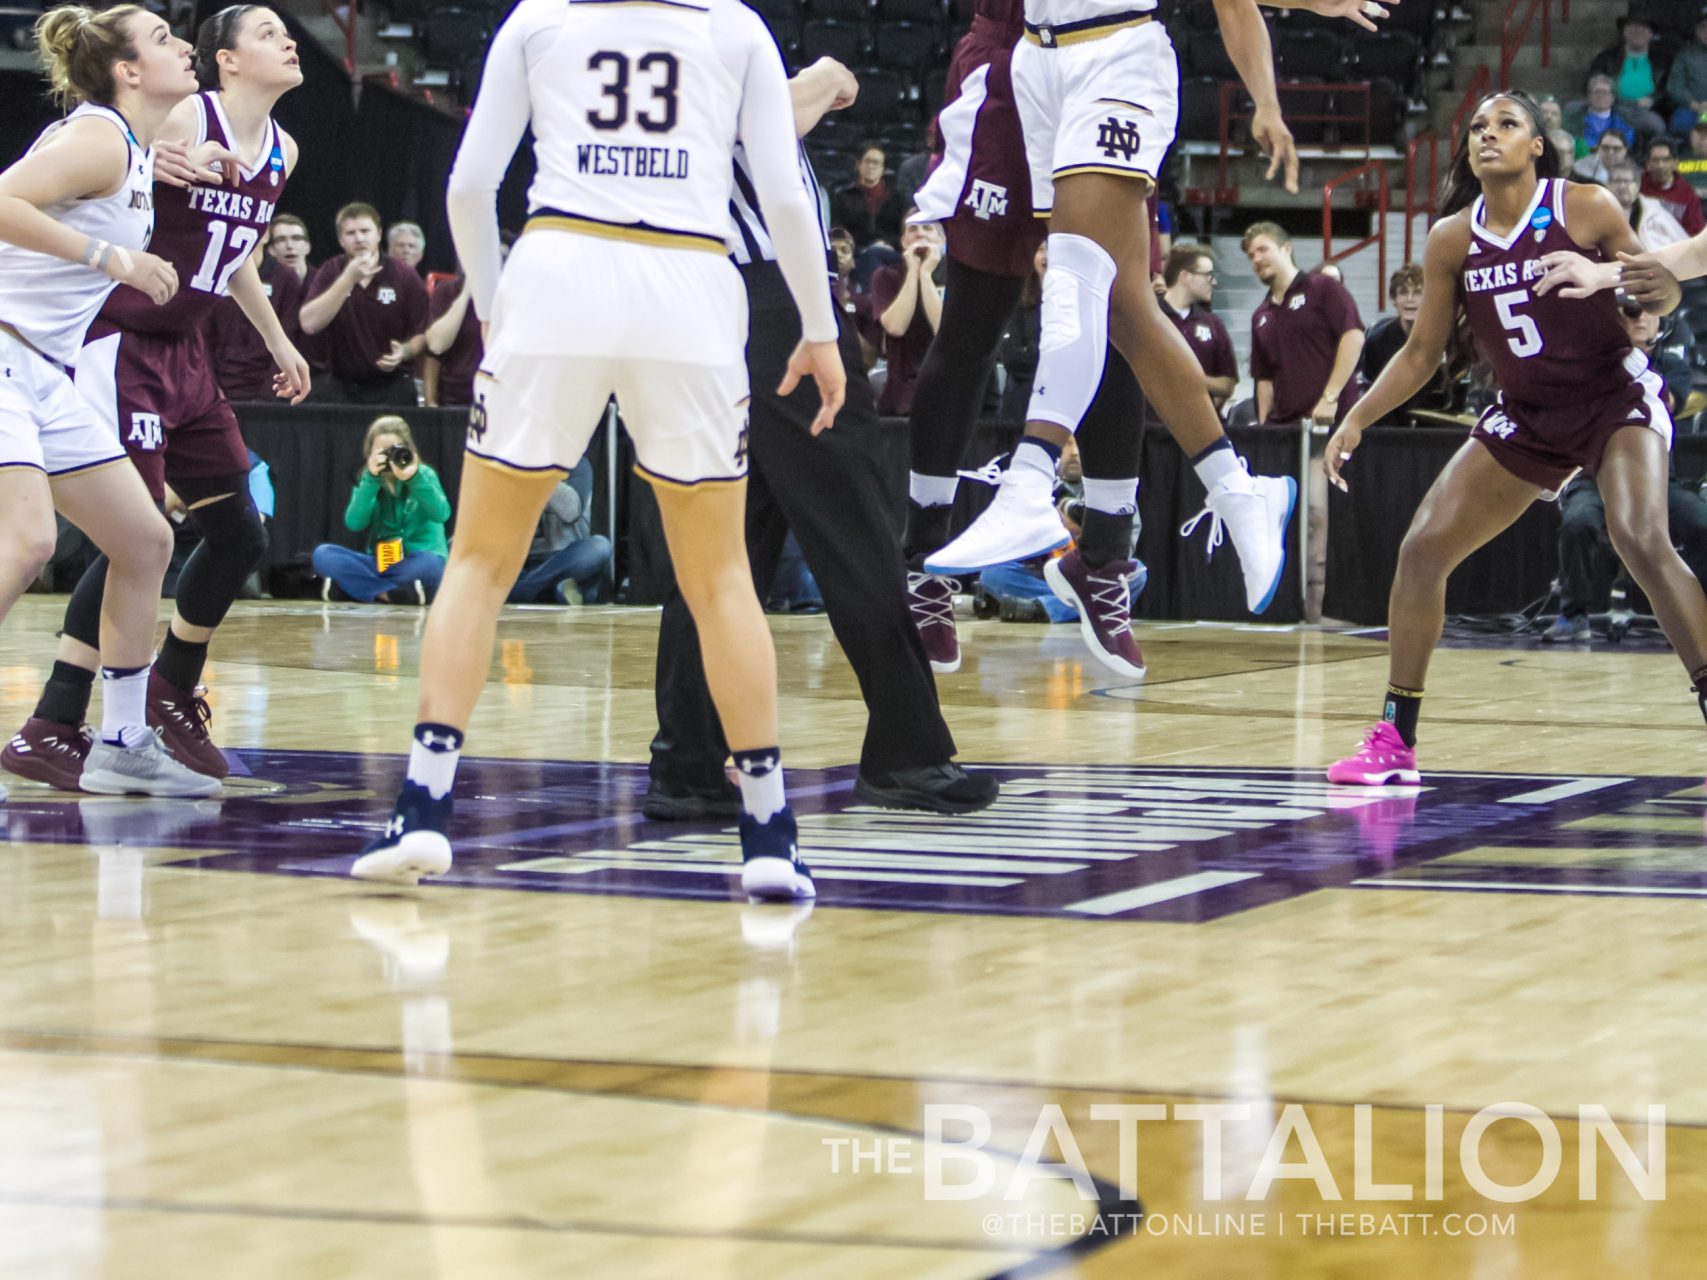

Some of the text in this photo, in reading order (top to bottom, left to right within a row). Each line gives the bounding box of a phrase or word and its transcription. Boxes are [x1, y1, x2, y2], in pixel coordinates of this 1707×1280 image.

[586, 49, 680, 134] 33
[576, 143, 690, 180] WESTBELD
[187, 186, 254, 220] TEXAS
[190, 220, 259, 297] 12
[1464, 262, 1518, 292] TEXAS
[1493, 289, 1544, 358] 5
